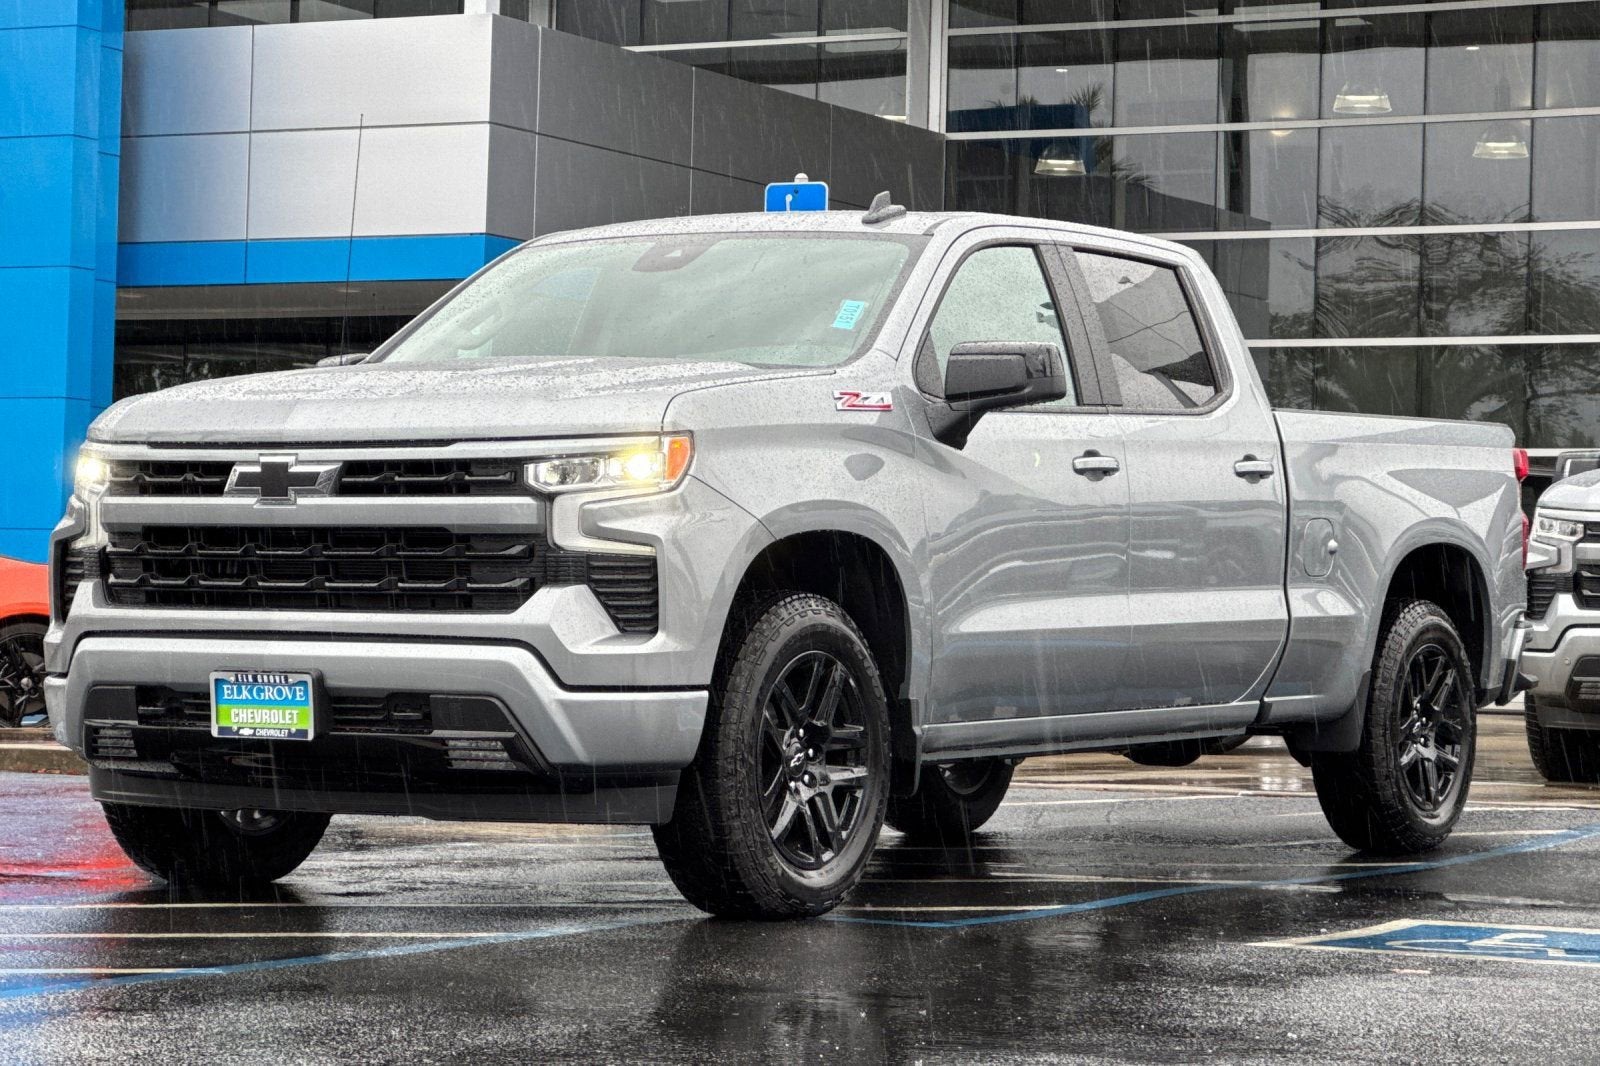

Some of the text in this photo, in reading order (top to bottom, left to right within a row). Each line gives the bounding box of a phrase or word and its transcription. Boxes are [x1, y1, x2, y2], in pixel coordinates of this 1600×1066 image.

[238, 674, 286, 684] ELK GROVE
[230, 708, 299, 724] CHEVROLET
[255, 728, 289, 737] CHEVROLET
